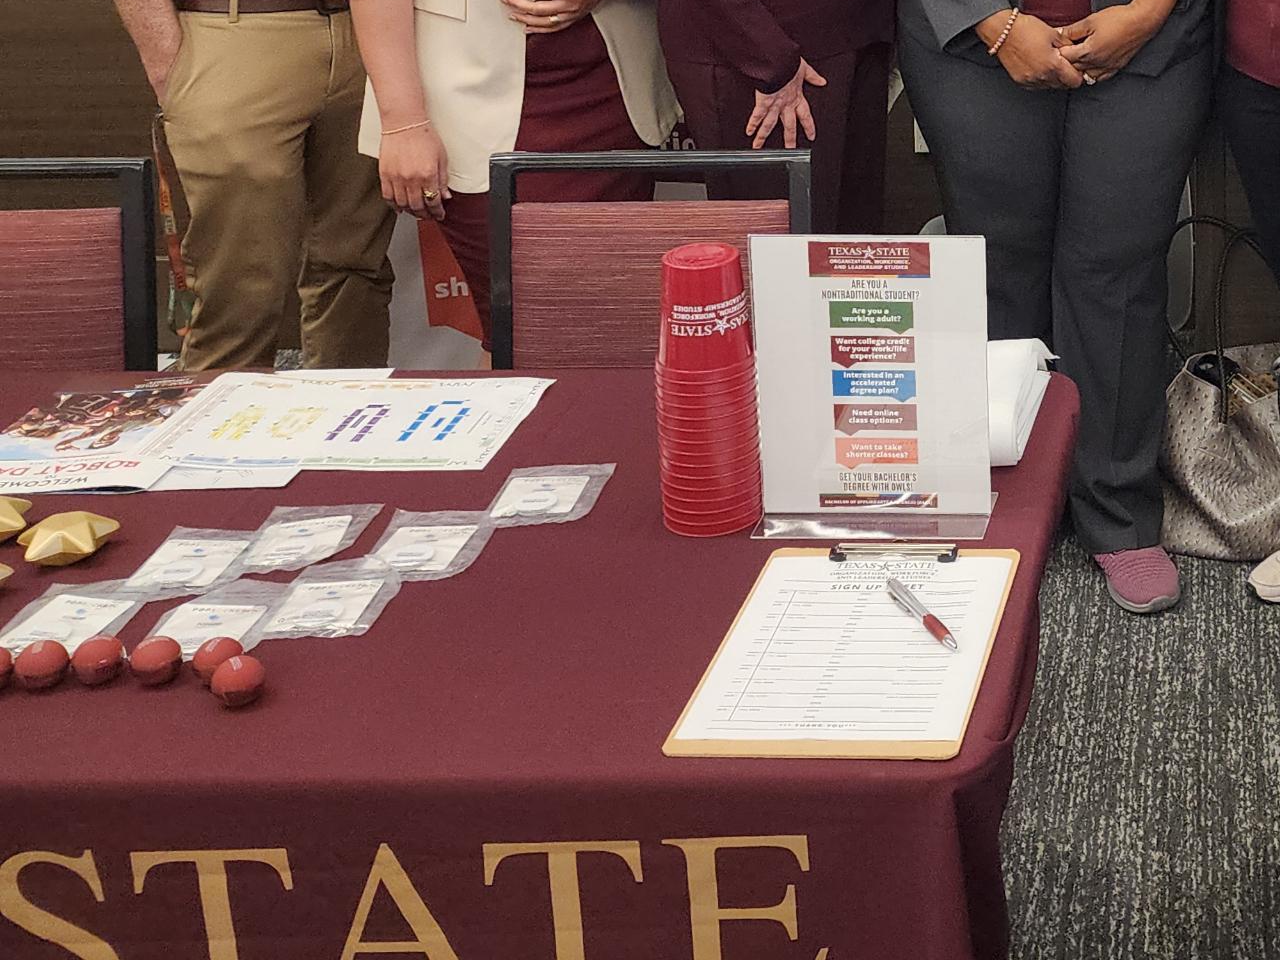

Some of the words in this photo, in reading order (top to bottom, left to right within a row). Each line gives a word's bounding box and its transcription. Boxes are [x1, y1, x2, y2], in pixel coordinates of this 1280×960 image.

[828, 246, 861, 256] TEXAS
[876, 247, 910, 256] STATE
[851, 279, 865, 289] ARE
[866, 279, 881, 289] YOU
[882, 279, 888, 289] A
[821, 290, 883, 300] NONTRADITIONAL
[885, 290, 920, 300] STUDENT?
[867, 308, 882, 316] you
[841, 315, 875, 323] working
[671, 324, 713, 337] STATE
[835, 337, 857, 345] Want
[857, 338, 886, 346] college
[843, 371, 884, 379] Interested
[884, 371, 893, 379] in
[849, 387, 877, 395] degree
[878, 387, 899, 395] plan?
[852, 408, 873, 416] Need
[869, 417, 903, 425] options?
[851, 443, 873, 451] Want
[884, 443, 903, 451] take
[876, 451, 908, 459] classes?
[34, 459, 141, 476] BOBCAT
[839, 472, 852, 481] GET
[853, 472, 872, 482] YOUR
[0, 476, 88, 488] WELCOME
[843, 482, 870, 491] DEGREE
[872, 482, 890, 491] WITH
